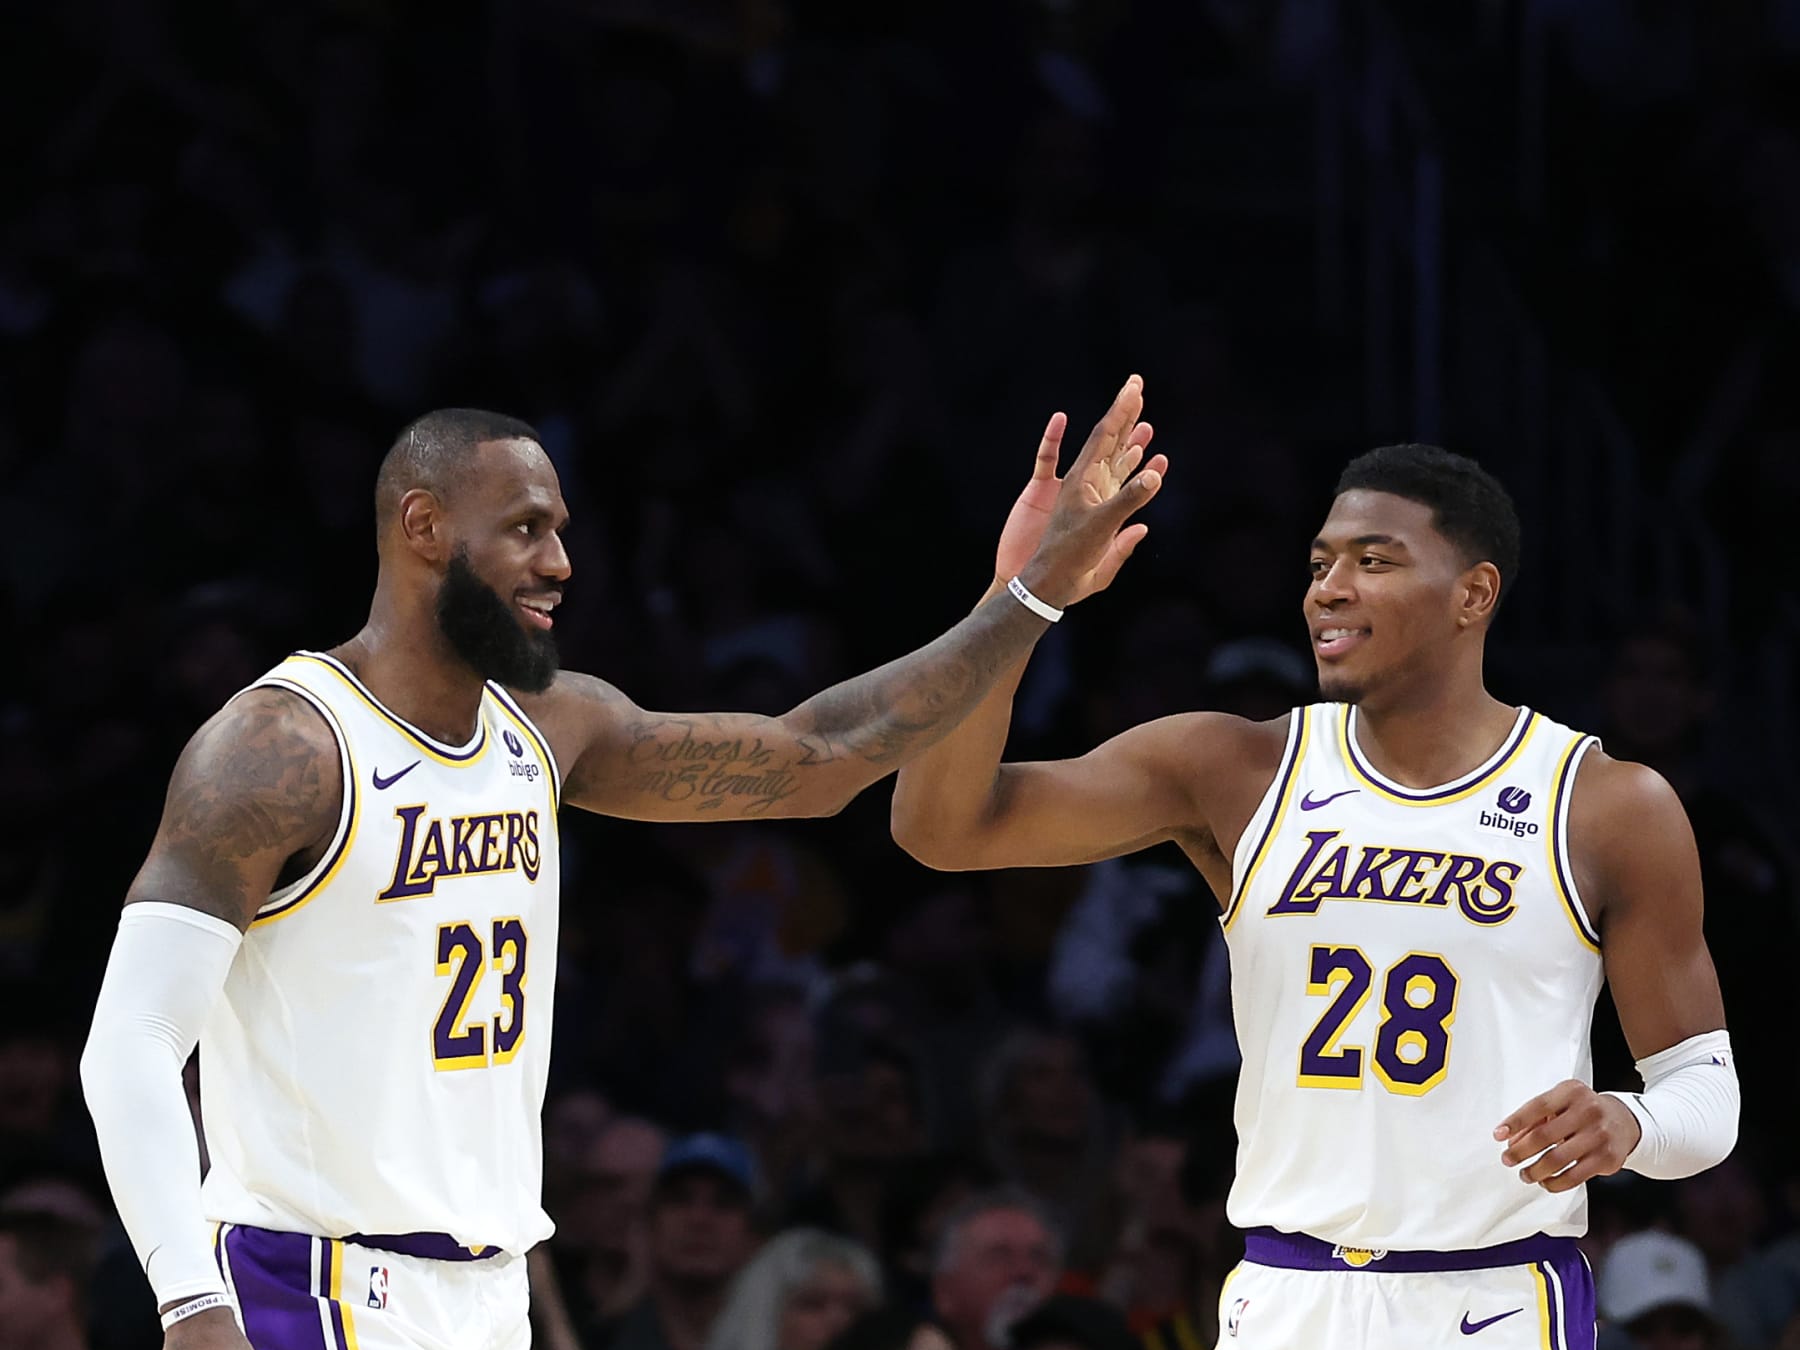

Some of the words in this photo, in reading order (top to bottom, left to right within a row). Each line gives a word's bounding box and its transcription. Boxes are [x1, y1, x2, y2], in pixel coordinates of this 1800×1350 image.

[508, 760, 539, 782] bibigo
[374, 802, 541, 904] LAKERS
[1480, 810, 1539, 838] bibigo
[1264, 829, 1526, 928] LAKERS
[430, 914, 529, 1073] 23
[1296, 943, 1462, 1098] 28
[173, 1296, 218, 1319] PROMISE
